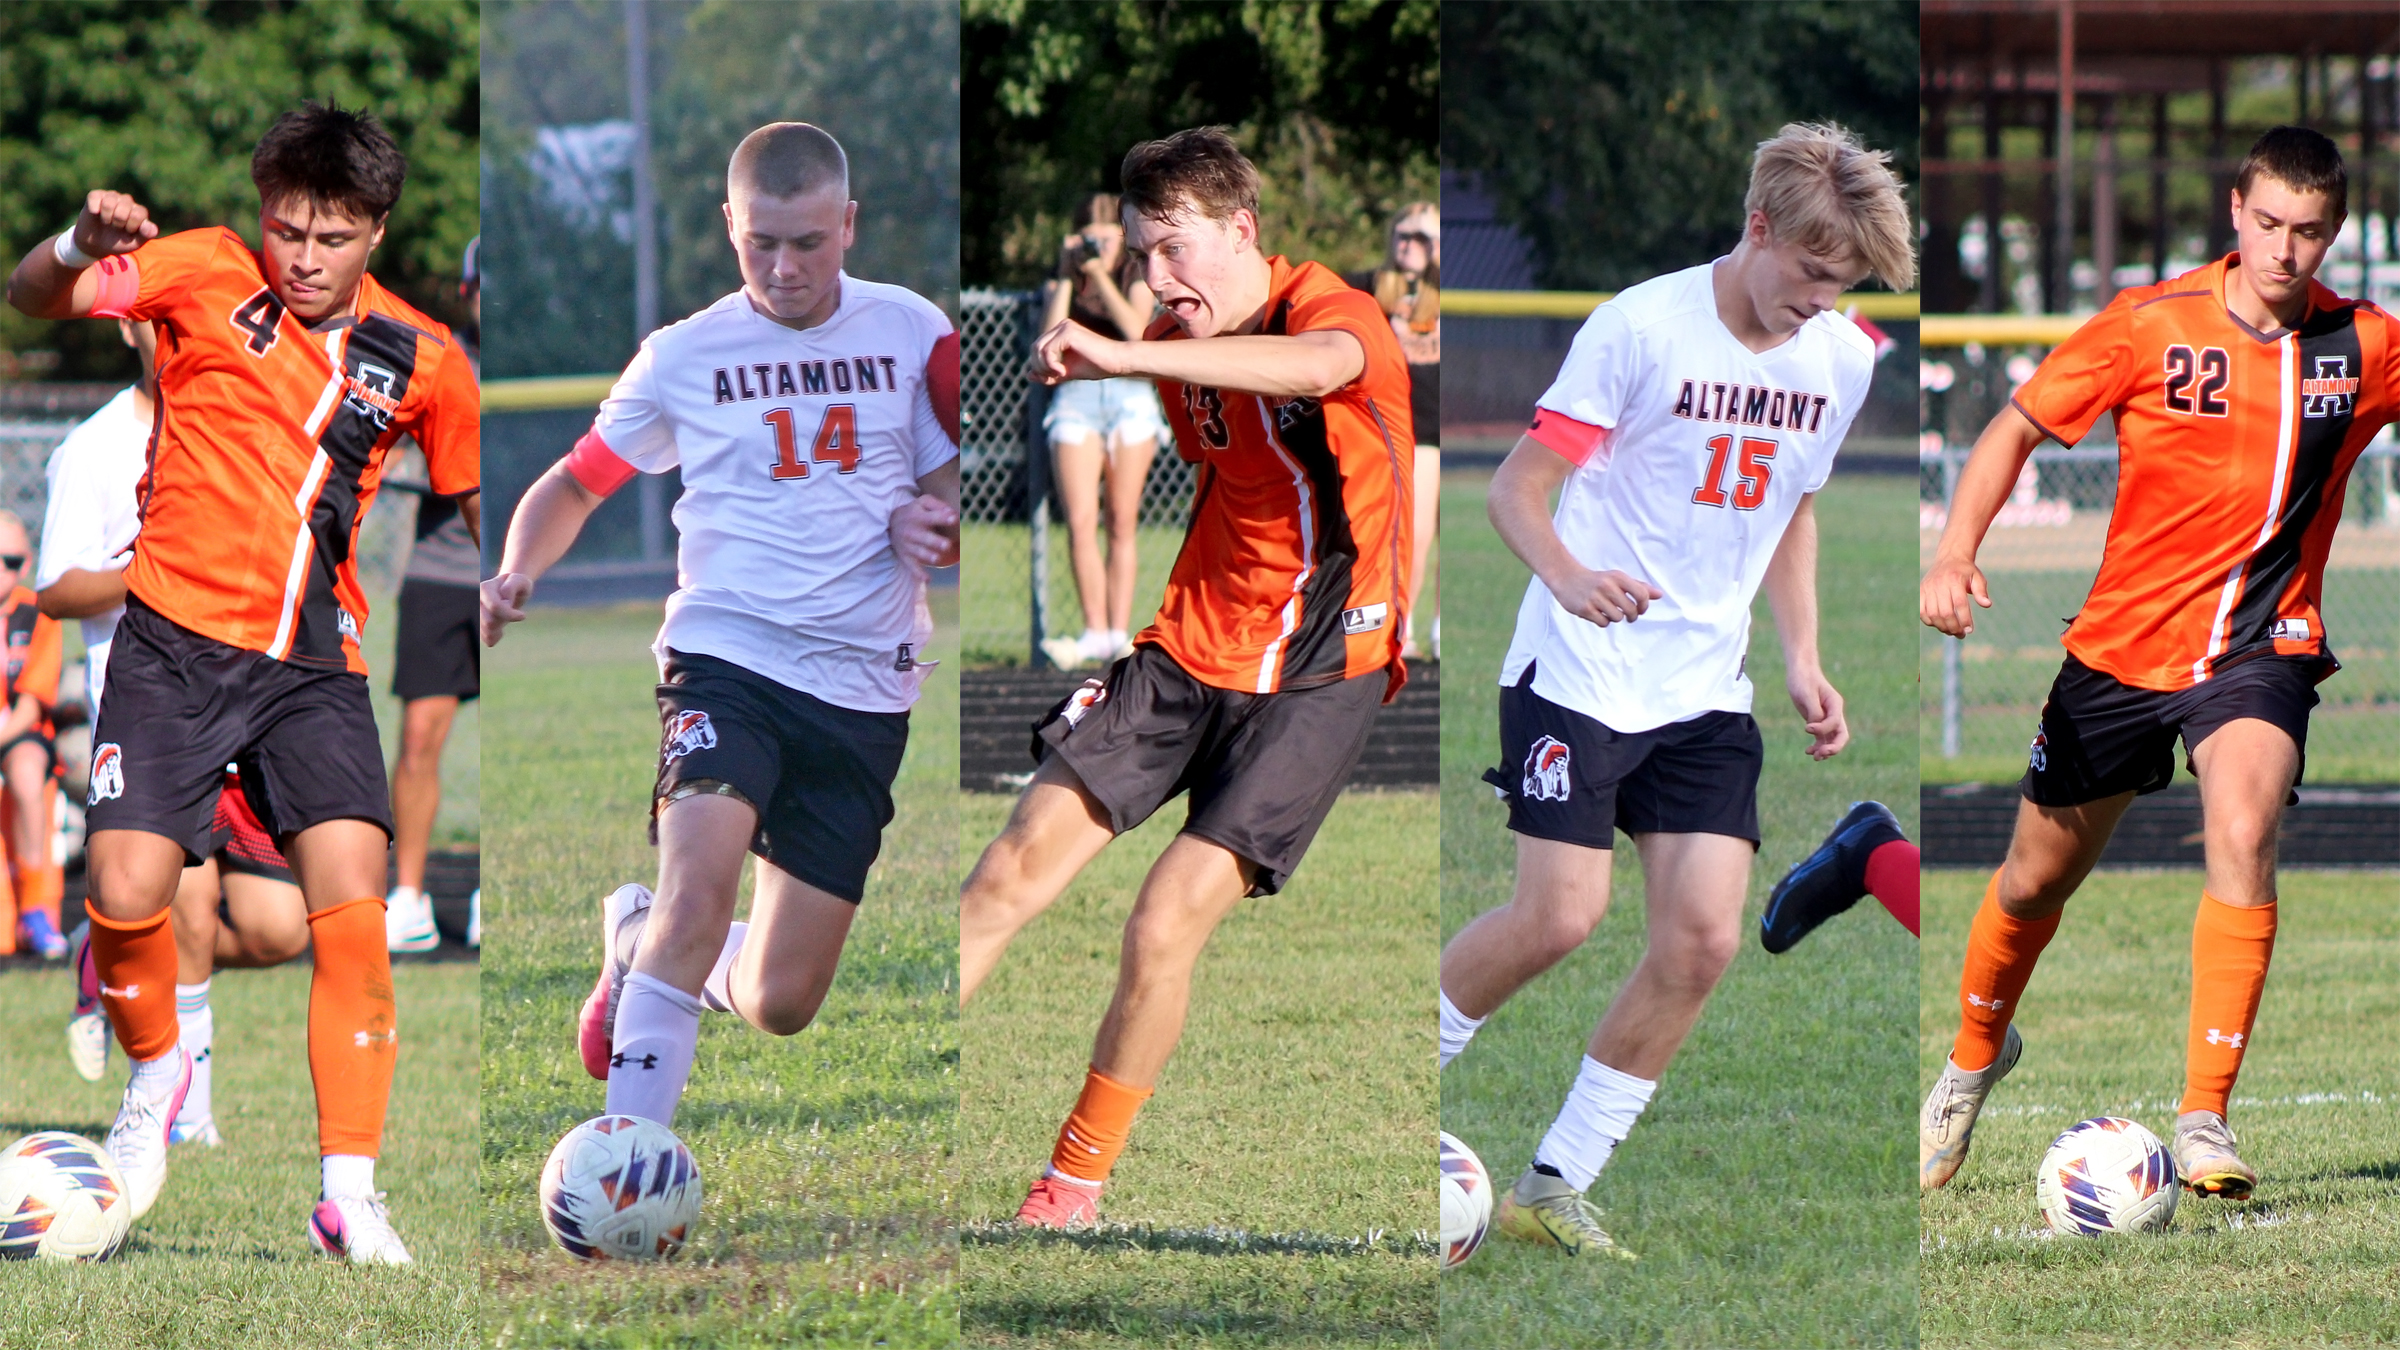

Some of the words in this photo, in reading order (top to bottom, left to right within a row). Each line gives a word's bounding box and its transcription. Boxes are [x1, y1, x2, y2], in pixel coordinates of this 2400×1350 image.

[229, 284, 288, 359] 4
[344, 375, 401, 416] TAMONT
[714, 355, 896, 405] ALTAMONT
[1671, 379, 1828, 433] ALTAMONT
[2164, 344, 2230, 418] 22
[2302, 377, 2359, 395] ALTAMONT
[762, 402, 863, 481] 14
[1691, 433, 1779, 511] 15
